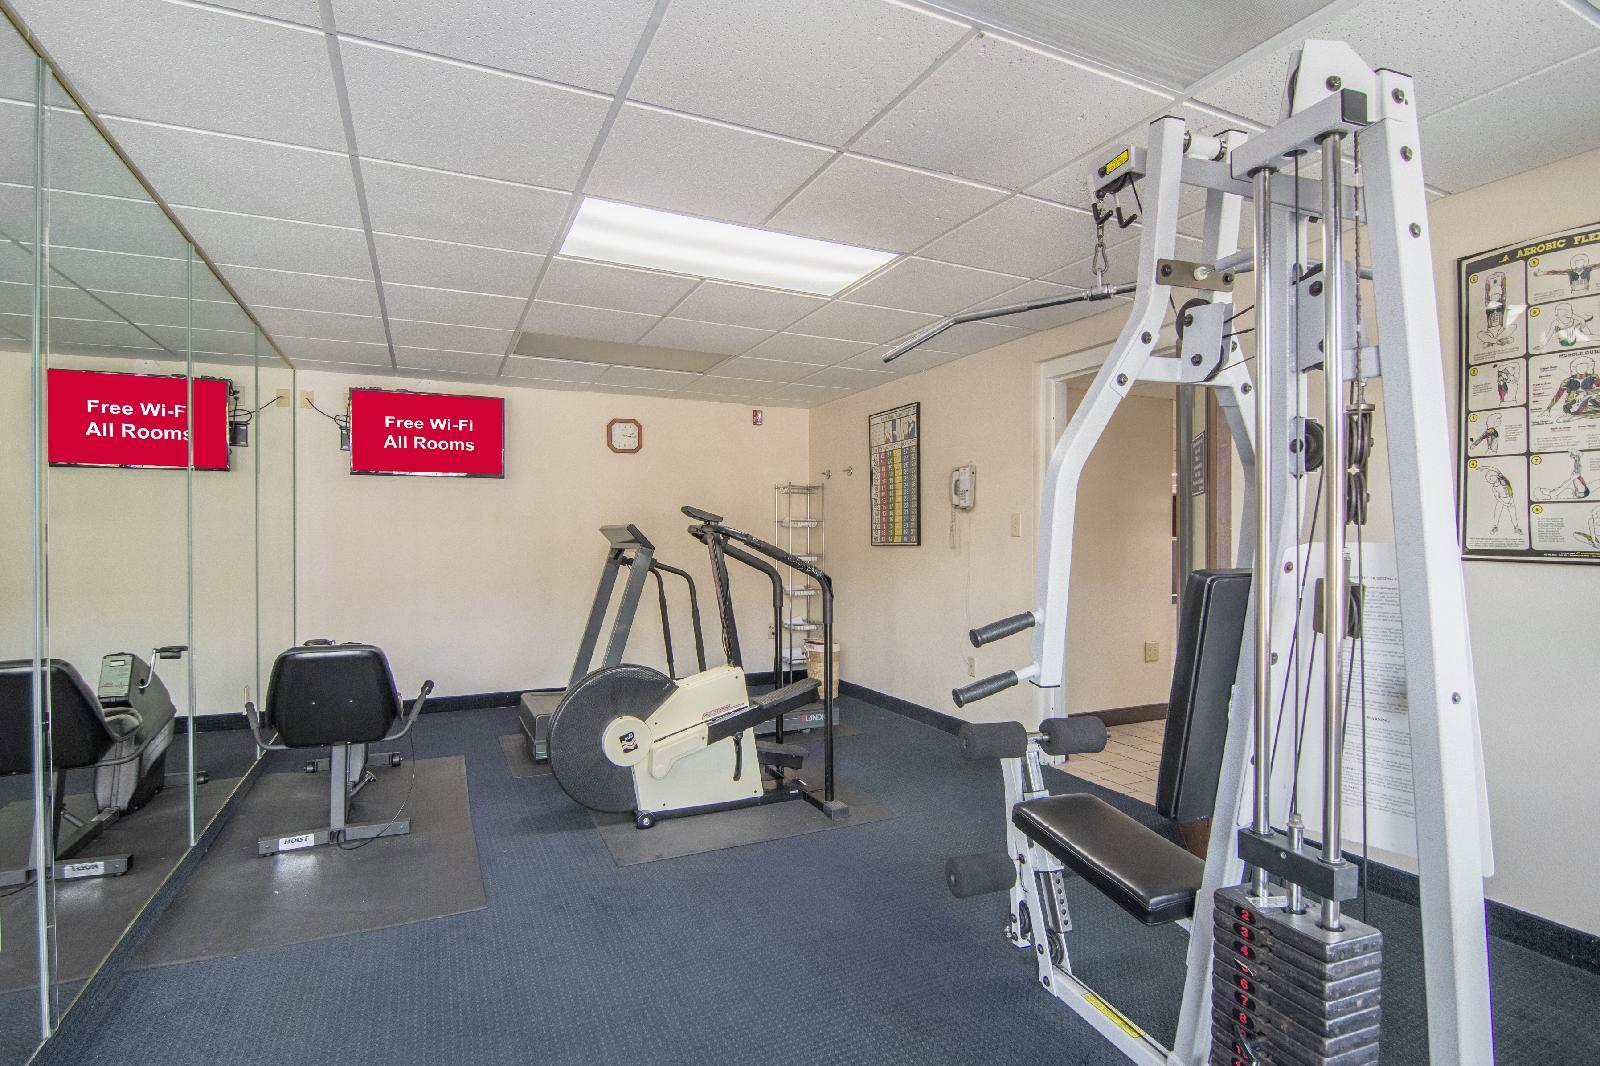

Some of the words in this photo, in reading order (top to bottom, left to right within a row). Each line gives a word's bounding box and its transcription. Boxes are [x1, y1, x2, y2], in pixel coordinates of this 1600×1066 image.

[1516, 240, 1566, 258] AEROBIC
[87, 399, 134, 416] Free
[140, 402, 187, 418] Wi-F
[384, 415, 424, 429] Free
[429, 418, 474, 432] Wi-Fi
[85, 421, 114, 438] All
[121, 423, 190, 441] Rooms
[383, 434, 408, 449] All
[413, 436, 475, 452] Rooms
[284, 836, 309, 844] HOIST
[1241, 908, 1249, 921] 2
[1240, 926, 1249, 939] 3
[1240, 944, 1249, 957] 4
[1240, 978, 1249, 990] 6
[1241, 994, 1249, 1007] 7
[1239, 1011, 1248, 1024] 8
